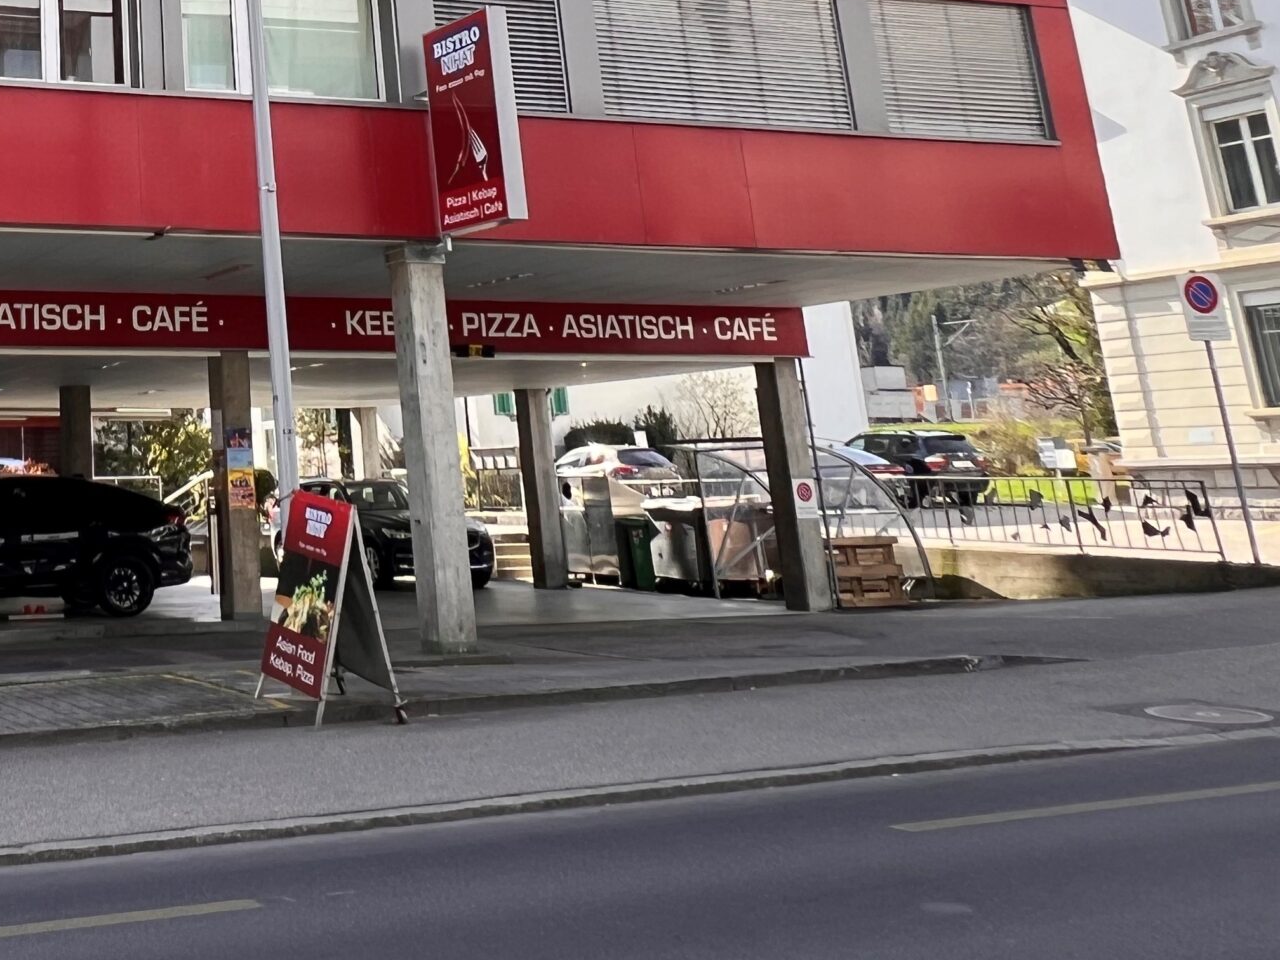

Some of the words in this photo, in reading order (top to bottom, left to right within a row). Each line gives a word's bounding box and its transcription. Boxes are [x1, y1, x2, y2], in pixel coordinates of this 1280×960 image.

[433, 26, 480, 59] BISTRO
[440, 44, 476, 75] NIHAT
[446, 196, 467, 208] Pizza
[472, 187, 497, 201] Kebap
[132, 301, 209, 332] CAFÉ
[461, 312, 542, 337] PIZZA
[562, 314, 694, 340] ASIATISCH
[714, 313, 778, 340] CAFÉ
[276, 635, 296, 655] Asian
[297, 644, 316, 665] Food
[295, 664, 315, 686] Pizza
